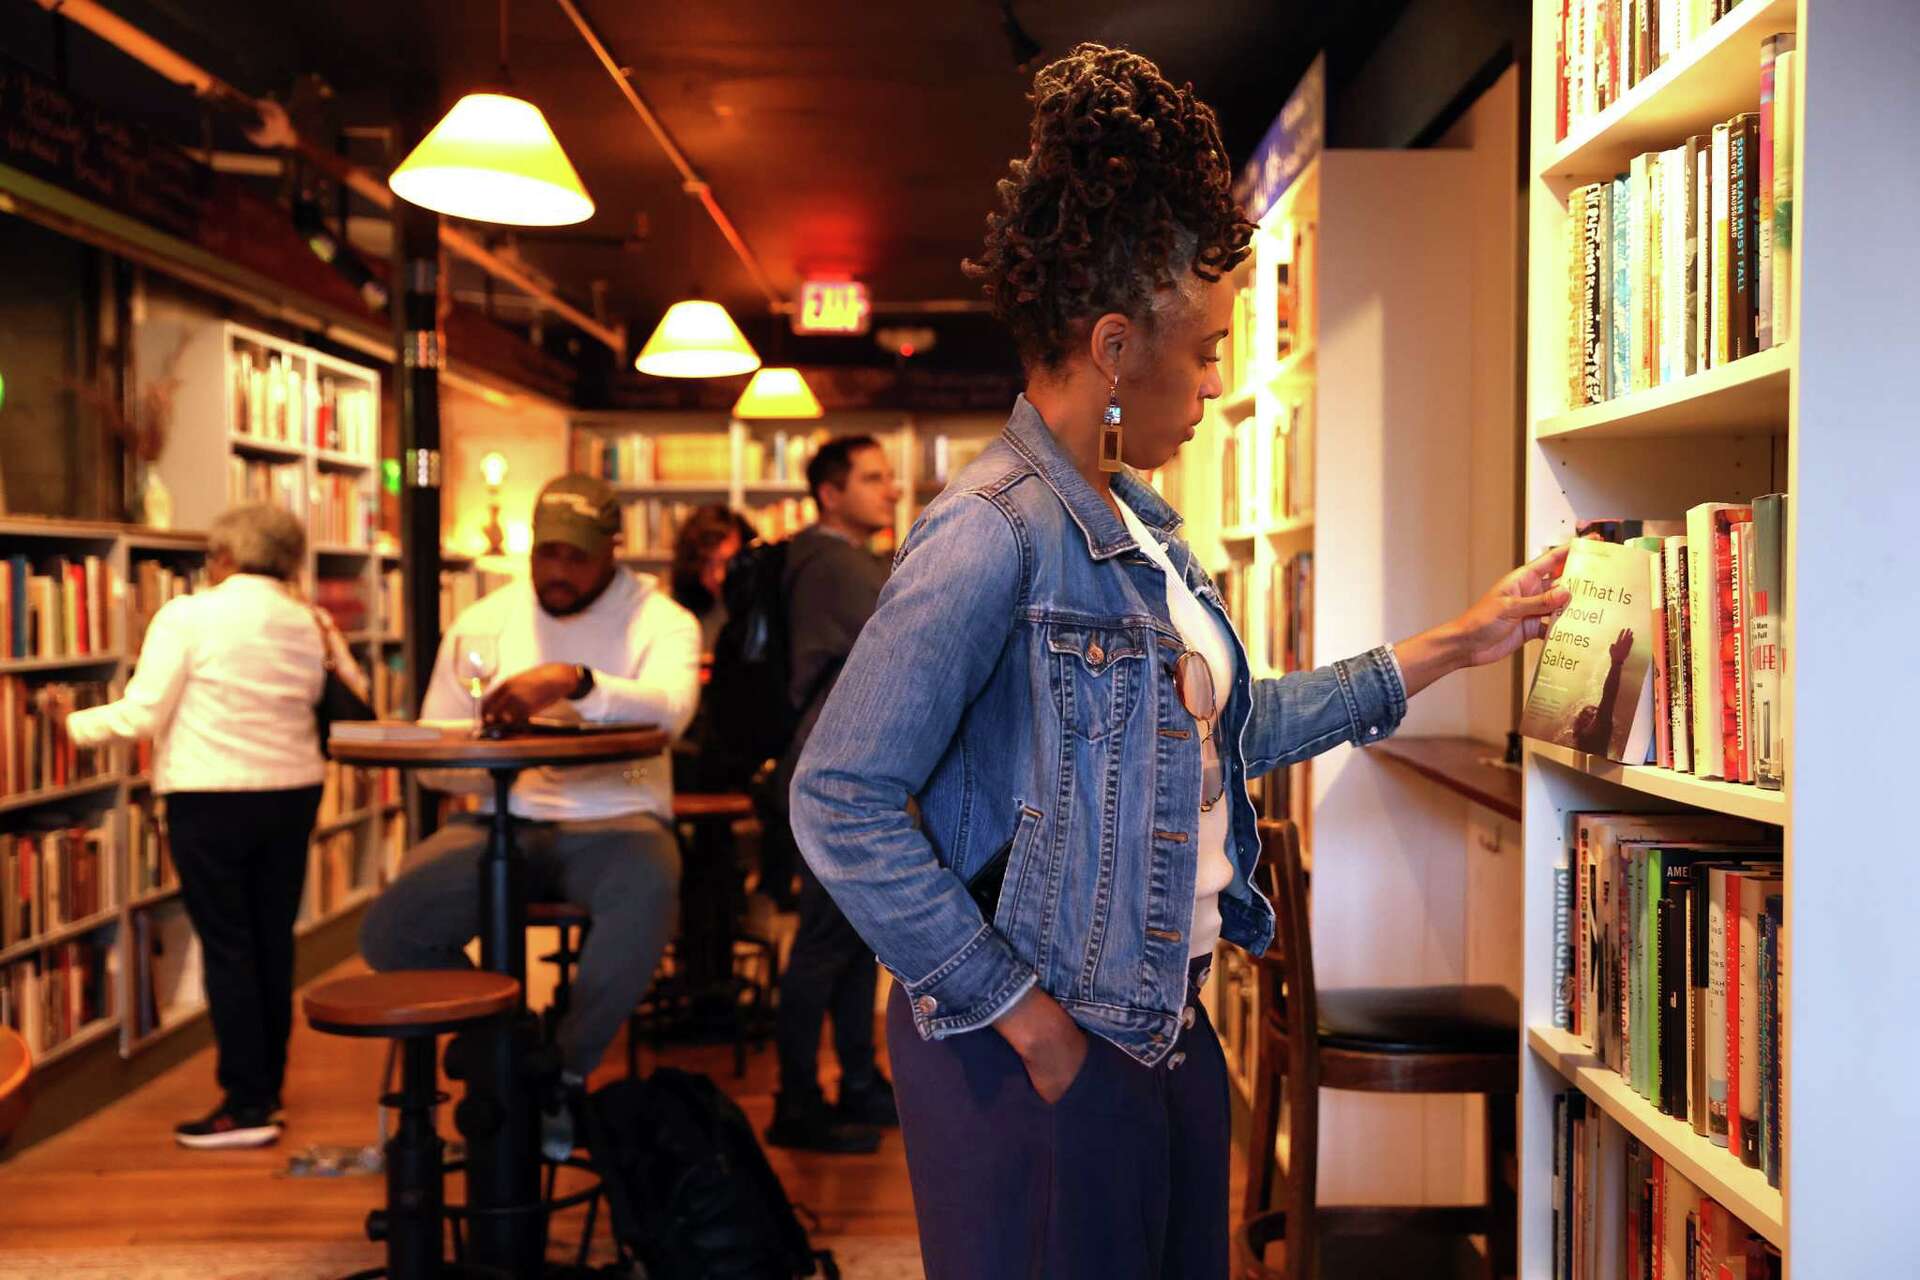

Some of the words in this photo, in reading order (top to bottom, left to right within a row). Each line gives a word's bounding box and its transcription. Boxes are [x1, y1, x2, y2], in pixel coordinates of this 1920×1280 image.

[1736, 137, 1744, 176] SOME
[1583, 579, 1615, 602] That
[1618, 587, 1633, 605] Is
[1565, 607, 1605, 625] novel
[1549, 628, 1591, 649] James
[1542, 651, 1580, 671] Salter
[1666, 865, 1688, 878] AME
